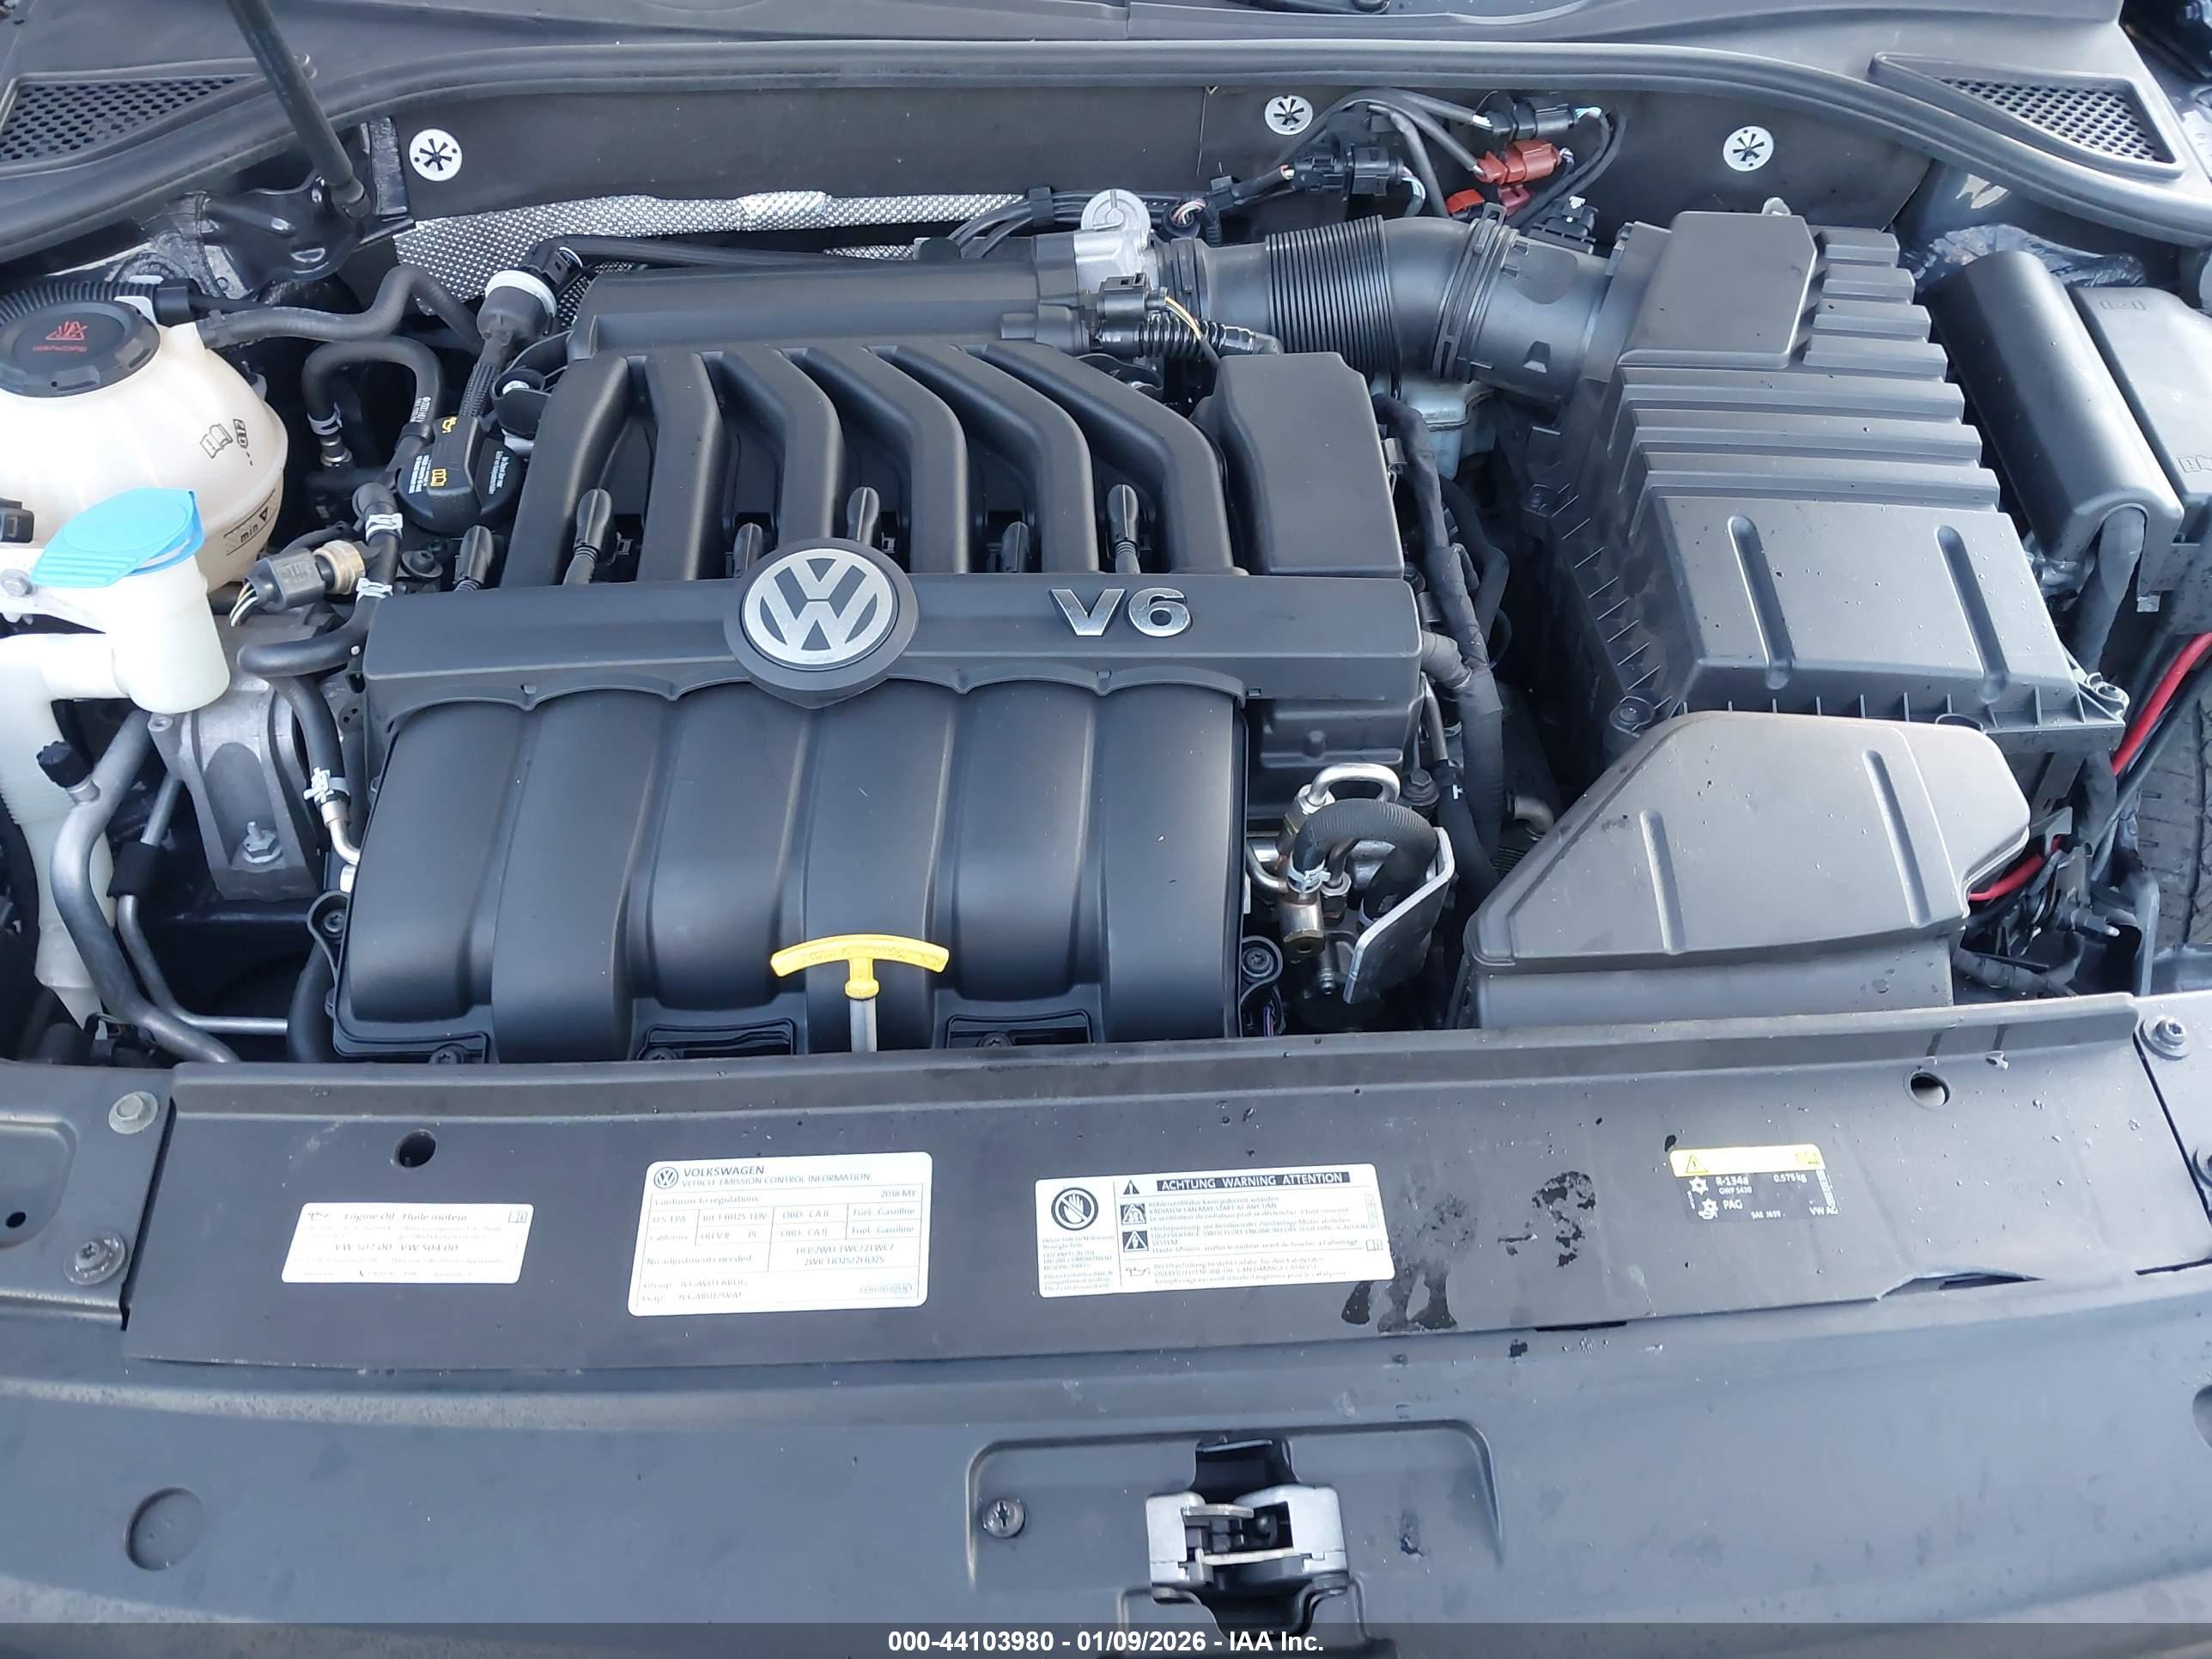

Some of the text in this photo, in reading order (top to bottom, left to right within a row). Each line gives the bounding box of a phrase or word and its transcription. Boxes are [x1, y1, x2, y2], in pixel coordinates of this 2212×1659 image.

[240, 523, 259, 544] min
[1050, 587, 1192, 638] V6
[684, 1165, 765, 1177] VOLKSWAGEN
[720, 1176, 762, 1186] EMISSION
[764, 1175, 804, 1184] CONTROL
[808, 1172, 871, 1182] INFORMATION
[1162, 1172, 1343, 1191] ACHTUNG WARNING ATTENTION
[1723, 1200, 1743, 1210] PAG
[1808, 1206, 1826, 1217] VW
